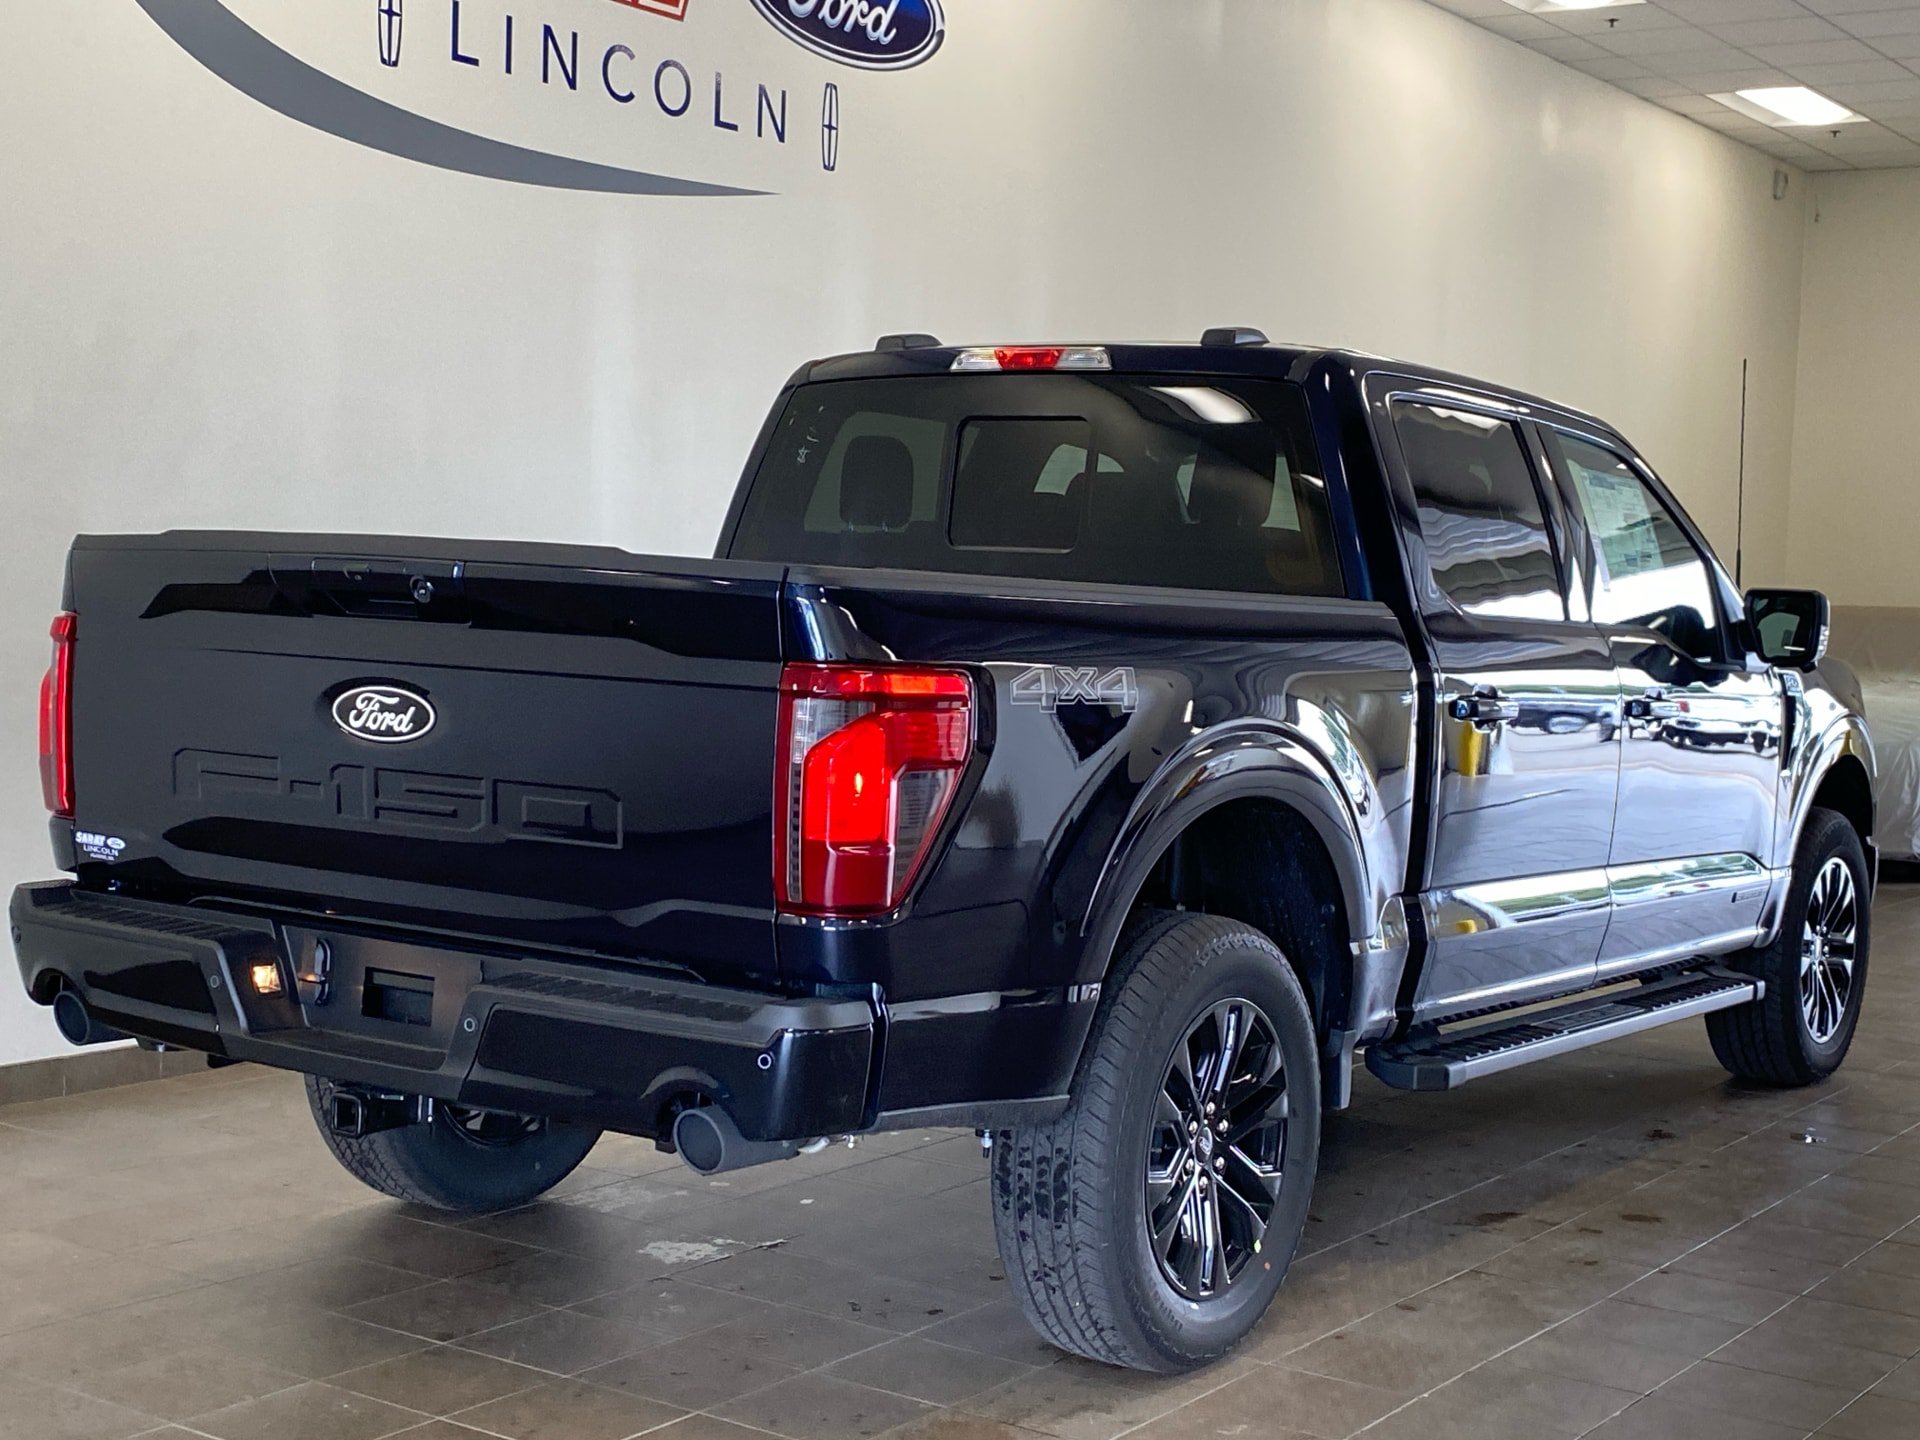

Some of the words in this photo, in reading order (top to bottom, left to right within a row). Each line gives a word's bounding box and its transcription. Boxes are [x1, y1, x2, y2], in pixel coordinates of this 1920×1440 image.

[451, 0, 787, 143] LINCOLN
[349, 693, 416, 733] Ford
[173, 747, 623, 849] F-150
[83, 844, 118, 856] LINCOLN
